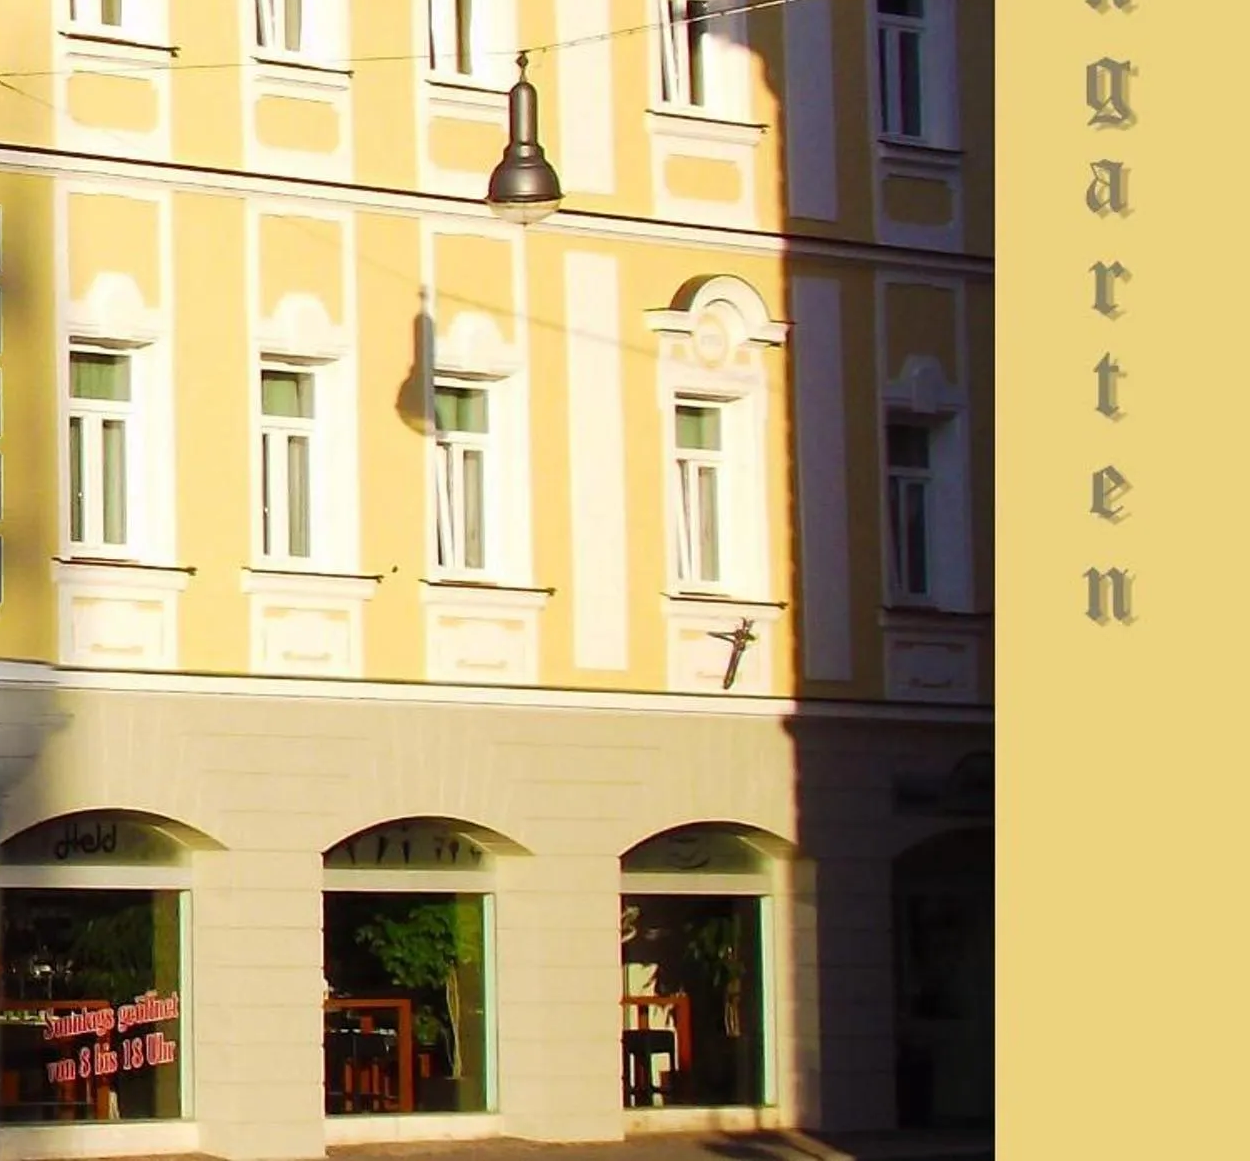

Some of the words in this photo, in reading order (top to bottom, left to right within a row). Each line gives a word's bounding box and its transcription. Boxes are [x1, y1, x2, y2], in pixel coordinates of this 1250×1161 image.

[54, 822, 117, 860] Held
[94, 1042, 118, 1075] bis
[123, 1037, 144, 1070] 18
[146, 1032, 176, 1065] Uhr
